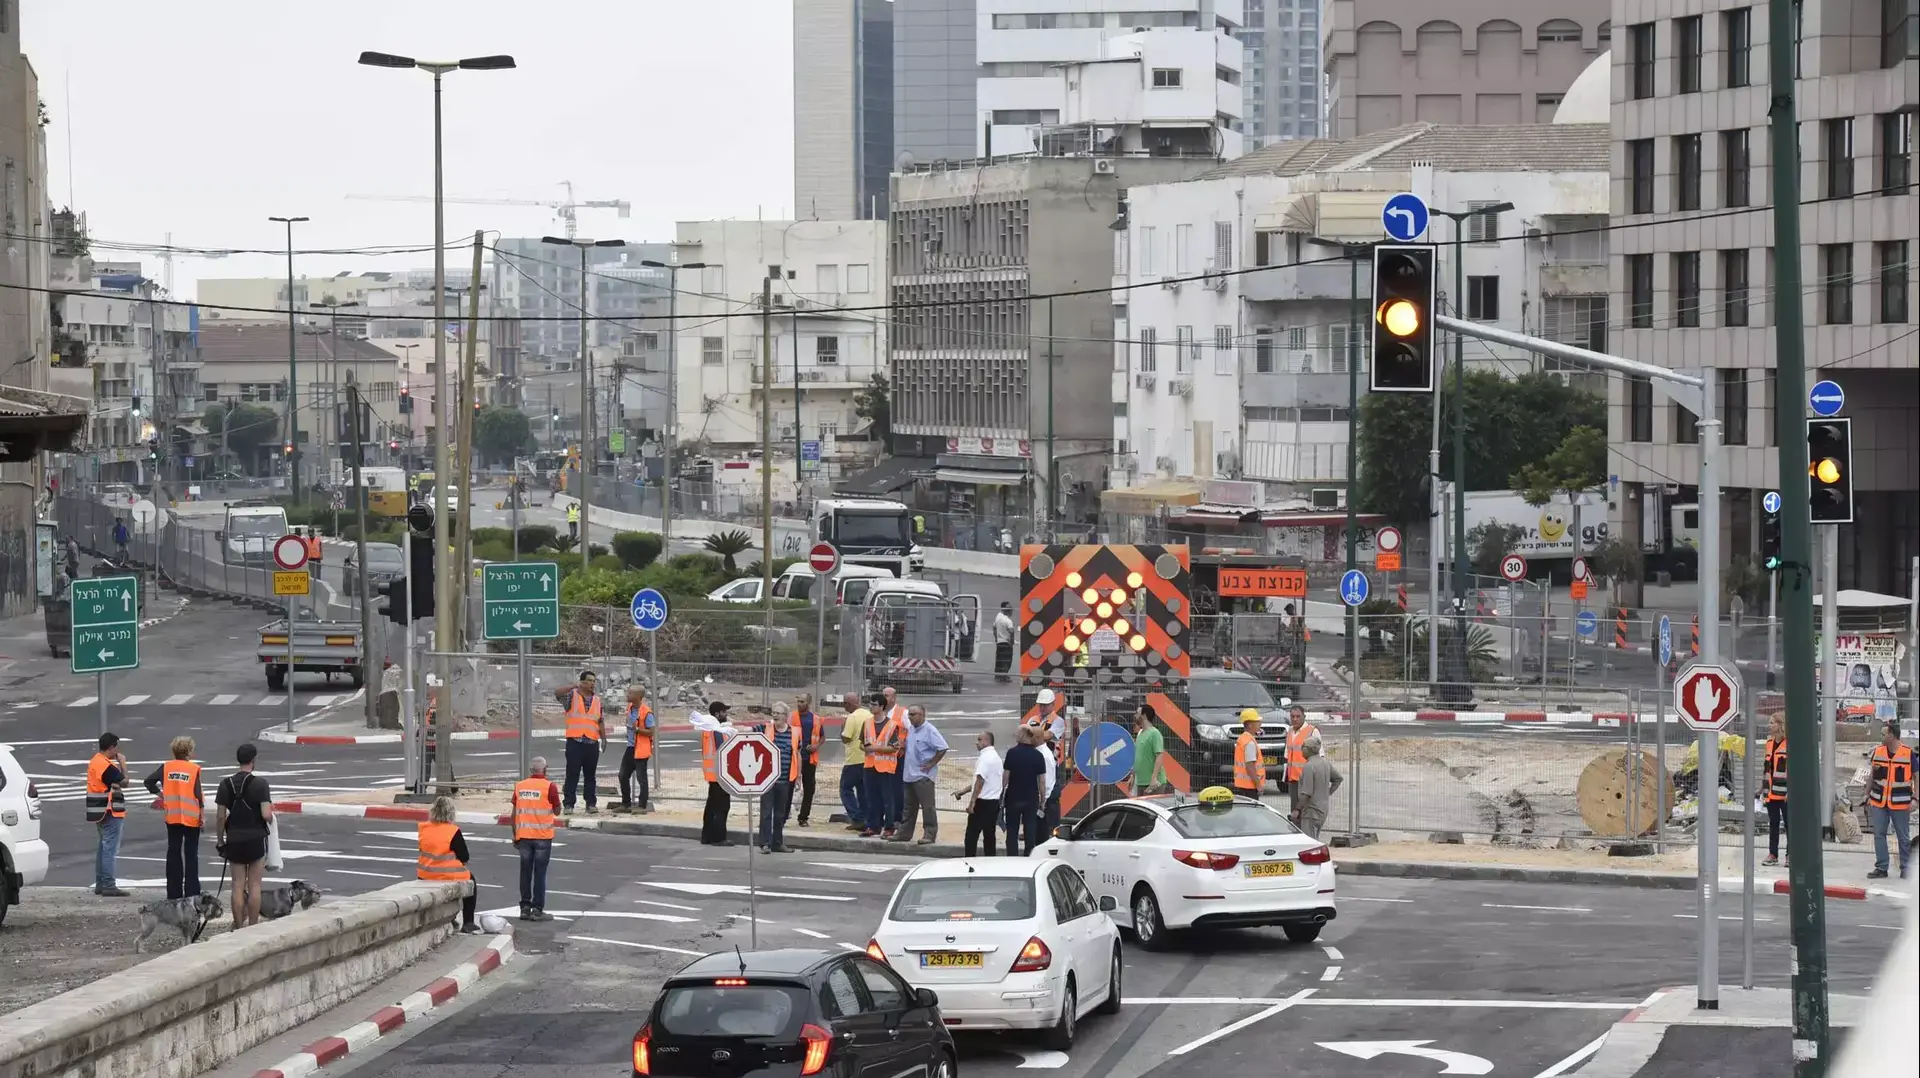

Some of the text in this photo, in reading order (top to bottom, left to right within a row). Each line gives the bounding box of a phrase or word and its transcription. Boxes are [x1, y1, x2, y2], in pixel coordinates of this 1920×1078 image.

[1507, 563, 1520, 573] 30
[489, 571, 515, 580] הרצל
[507, 584, 521, 593] יפו
[1222, 575, 1302, 592] קבוצת צבע
[76, 588, 100, 600] הרצל
[92, 604, 105, 614] יפו
[492, 605, 551, 617] נתיבי איילון
[79, 629, 131, 645] נתיבי איילון
[713, 1050, 730, 1059] KIA
